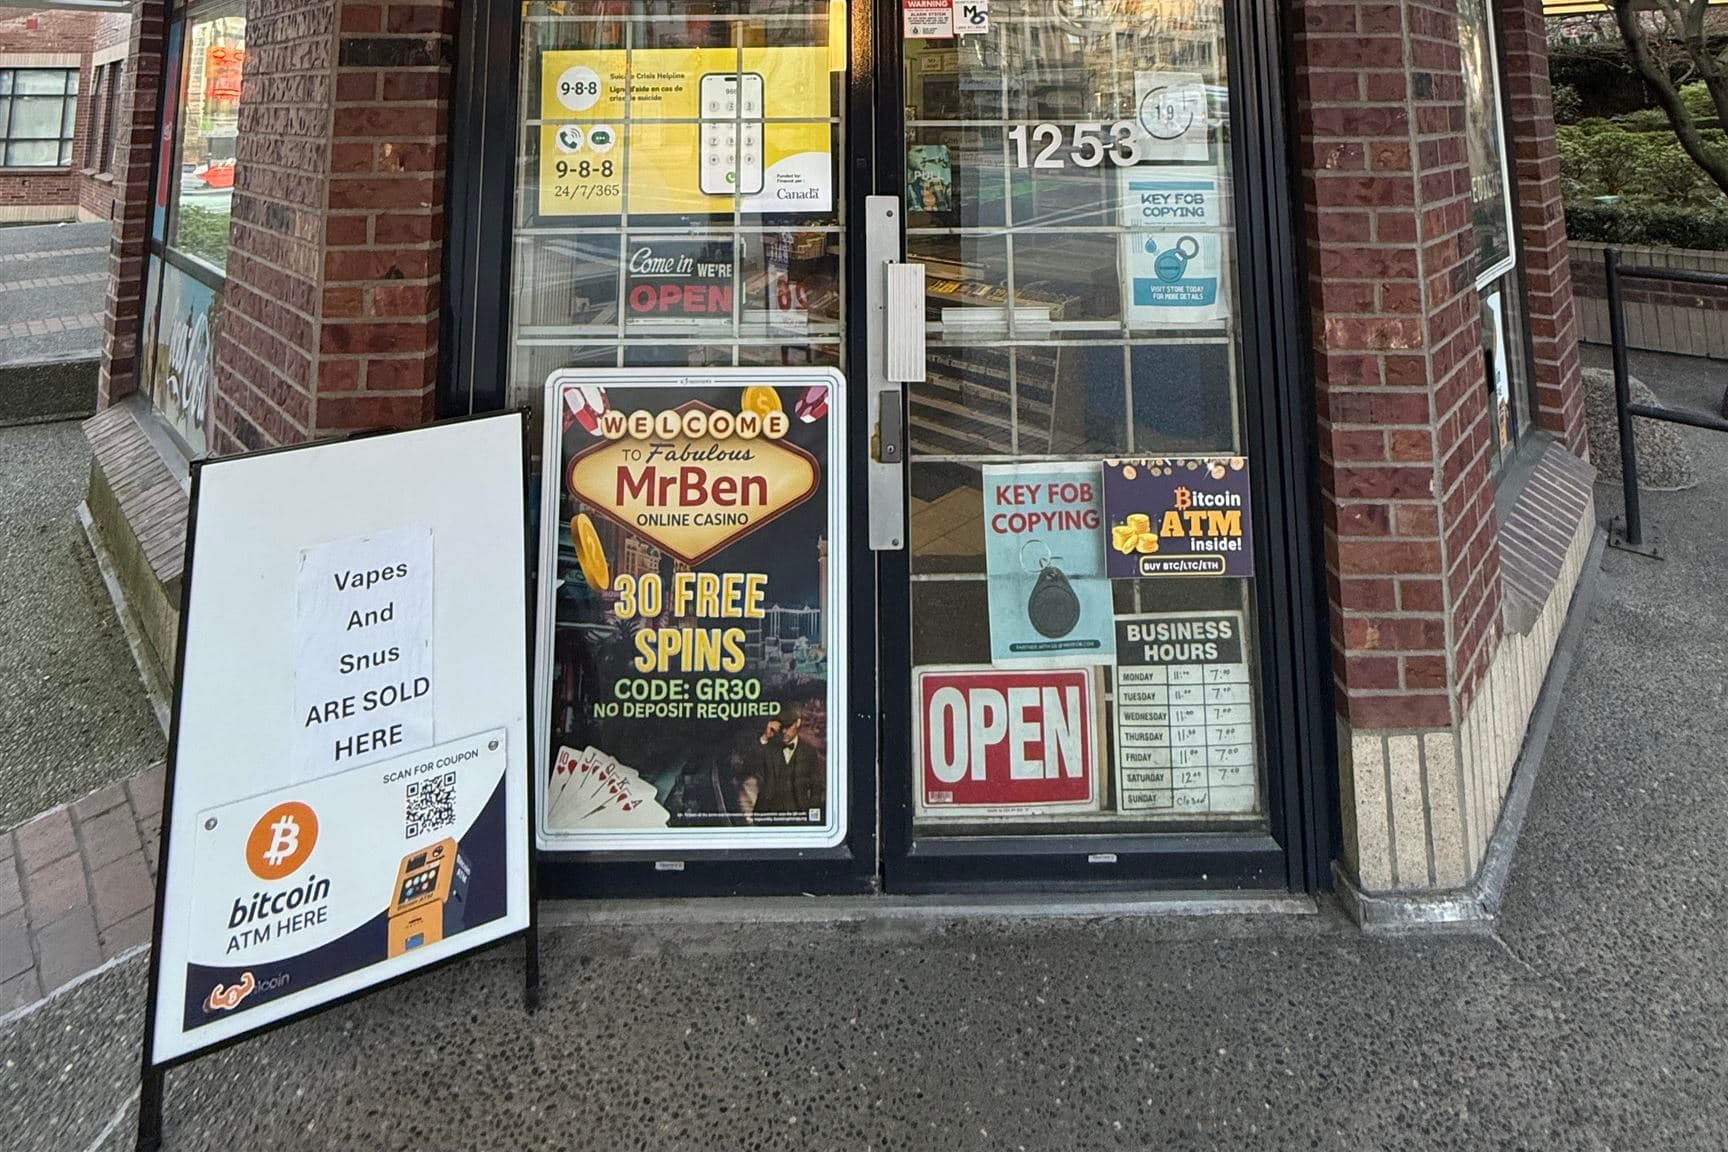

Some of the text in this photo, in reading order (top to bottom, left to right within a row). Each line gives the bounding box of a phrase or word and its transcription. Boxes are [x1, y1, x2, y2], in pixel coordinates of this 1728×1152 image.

[1008, 121, 1142, 169] 1253
[556, 160, 613, 178] 9-8-8
[555, 184, 620, 199] 24/7/365
[777, 188, 819, 200] Canada
[1141, 193, 1204, 205] KEY FOB
[1143, 207, 1205, 217] COPYING
[630, 247, 732, 278] Come in WE'RE
[629, 284, 732, 312] OPEN
[604, 413, 783, 435] WELCOME
[622, 442, 756, 463] TO Fabulous
[615, 465, 768, 508] MrBen
[996, 482, 1094, 505] KEY FOB
[1174, 486, 1241, 510] Bitcoin
[637, 511, 749, 527] ONLINE CASINO
[991, 509, 1100, 534] COPYING
[1160, 510, 1242, 537] ATM
[1191, 537, 1242, 551] inside!
[334, 563, 408, 591] Vapes
[1144, 562, 1161, 571] BUY
[613, 572, 768, 620] 30 FREE
[346, 602, 393, 631] And
[1127, 621, 1232, 642] BUSINESS
[339, 646, 400, 674] Snus
[634, 627, 746, 673] SPINS
[1144, 643, 1218, 662] HOURS
[1123, 673, 1153, 681] MONDAY
[614, 678, 761, 702] CODE: GR30
[1124, 692, 1155, 700] TUESDAY
[304, 676, 430, 727] ARE SOLD
[593, 700, 781, 720] NO DEPOSIT REQUIRED
[1124, 712, 1167, 721] WEDNESDAY
[335, 724, 403, 761] HERE
[929, 686, 1083, 783] OPEN
[1125, 732, 1163, 741] THURSDAY
[383, 748, 479, 784] SCAN FOR COUPON
[1126, 753, 1151, 761] FRIDAY
[1127, 774, 1164, 782] SATURDAY
[1128, 794, 1157, 803] SUNDAY
[227, 874, 330, 929] bitcoin
[226, 905, 328, 955] ATM HERE
